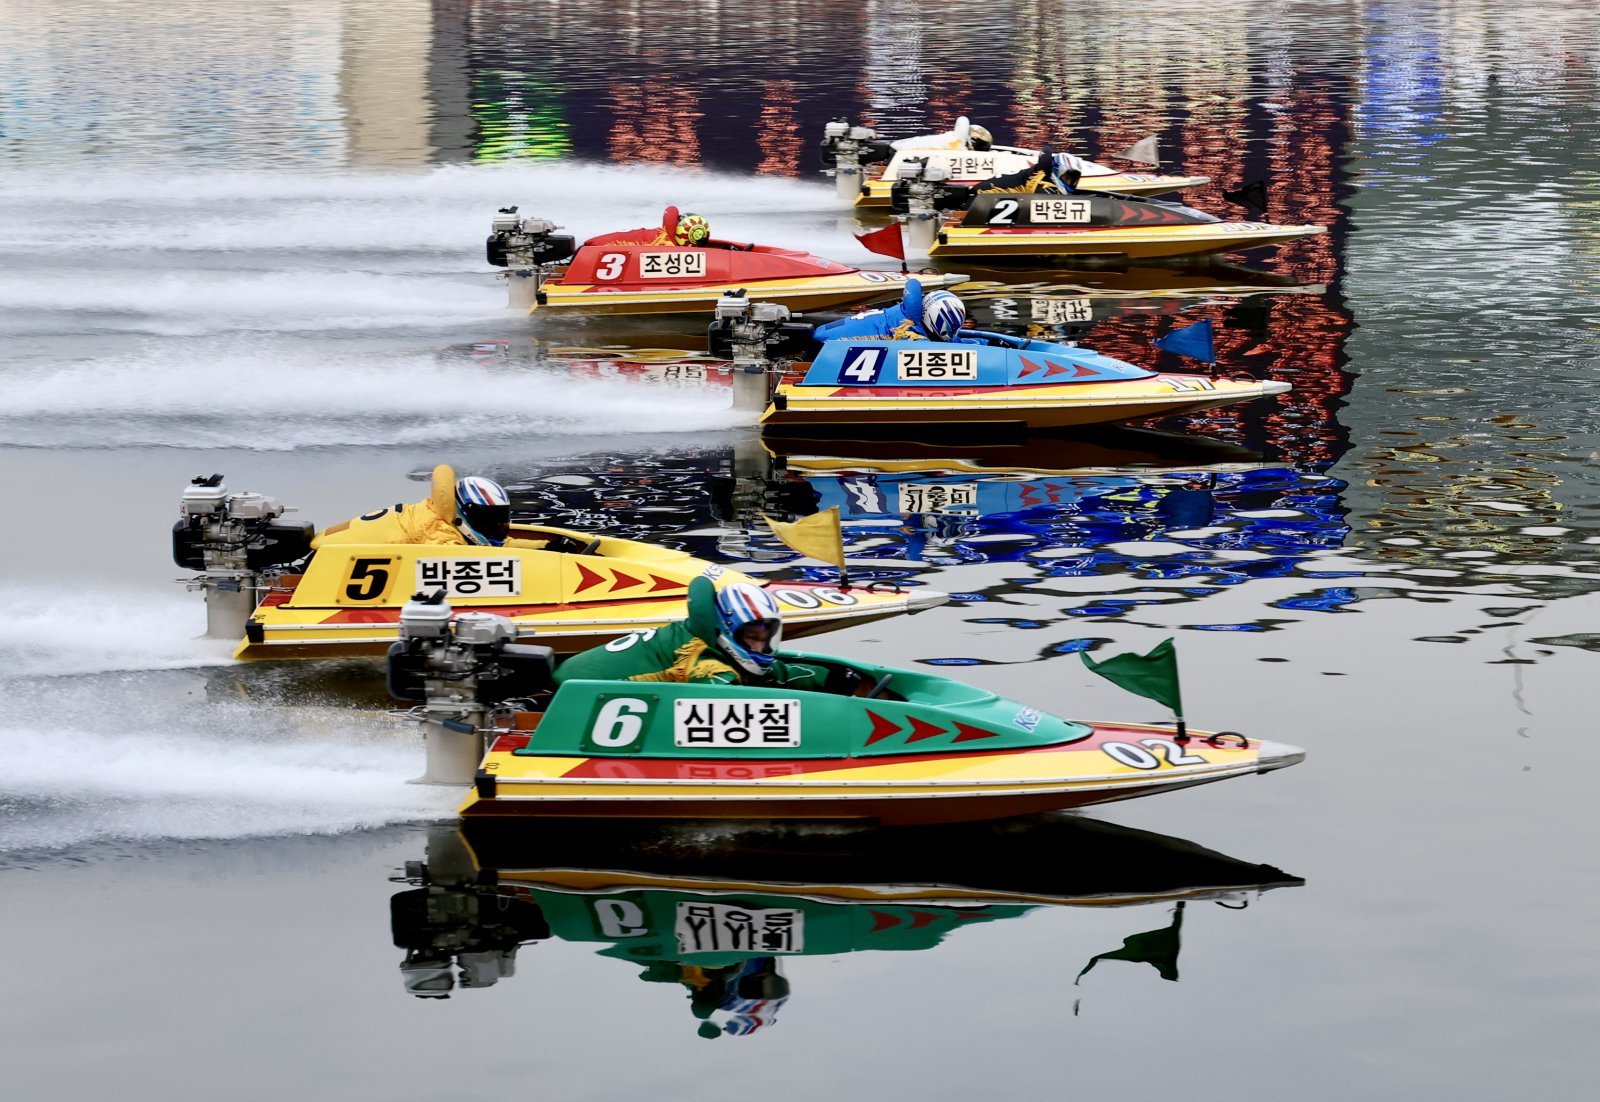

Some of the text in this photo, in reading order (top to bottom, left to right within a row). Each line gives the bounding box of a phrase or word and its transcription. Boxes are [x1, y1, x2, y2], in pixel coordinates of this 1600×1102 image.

[949, 157, 995, 175] 김완석
[989, 199, 1019, 224] 2
[1035, 201, 1086, 221] 박원규
[596, 253, 626, 280] 3
[644, 253, 701, 275] 조성인
[844, 349, 880, 382] 4
[903, 352, 971, 378] 김종민
[1156, 377, 1216, 392] 17
[346, 558, 392, 601] 5
[422, 560, 514, 594] 박종덕
[772, 587, 859, 609] 06
[591, 697, 649, 748] 6
[684, 703, 790, 743] 심상철
[1099, 738, 1210, 770] 02
